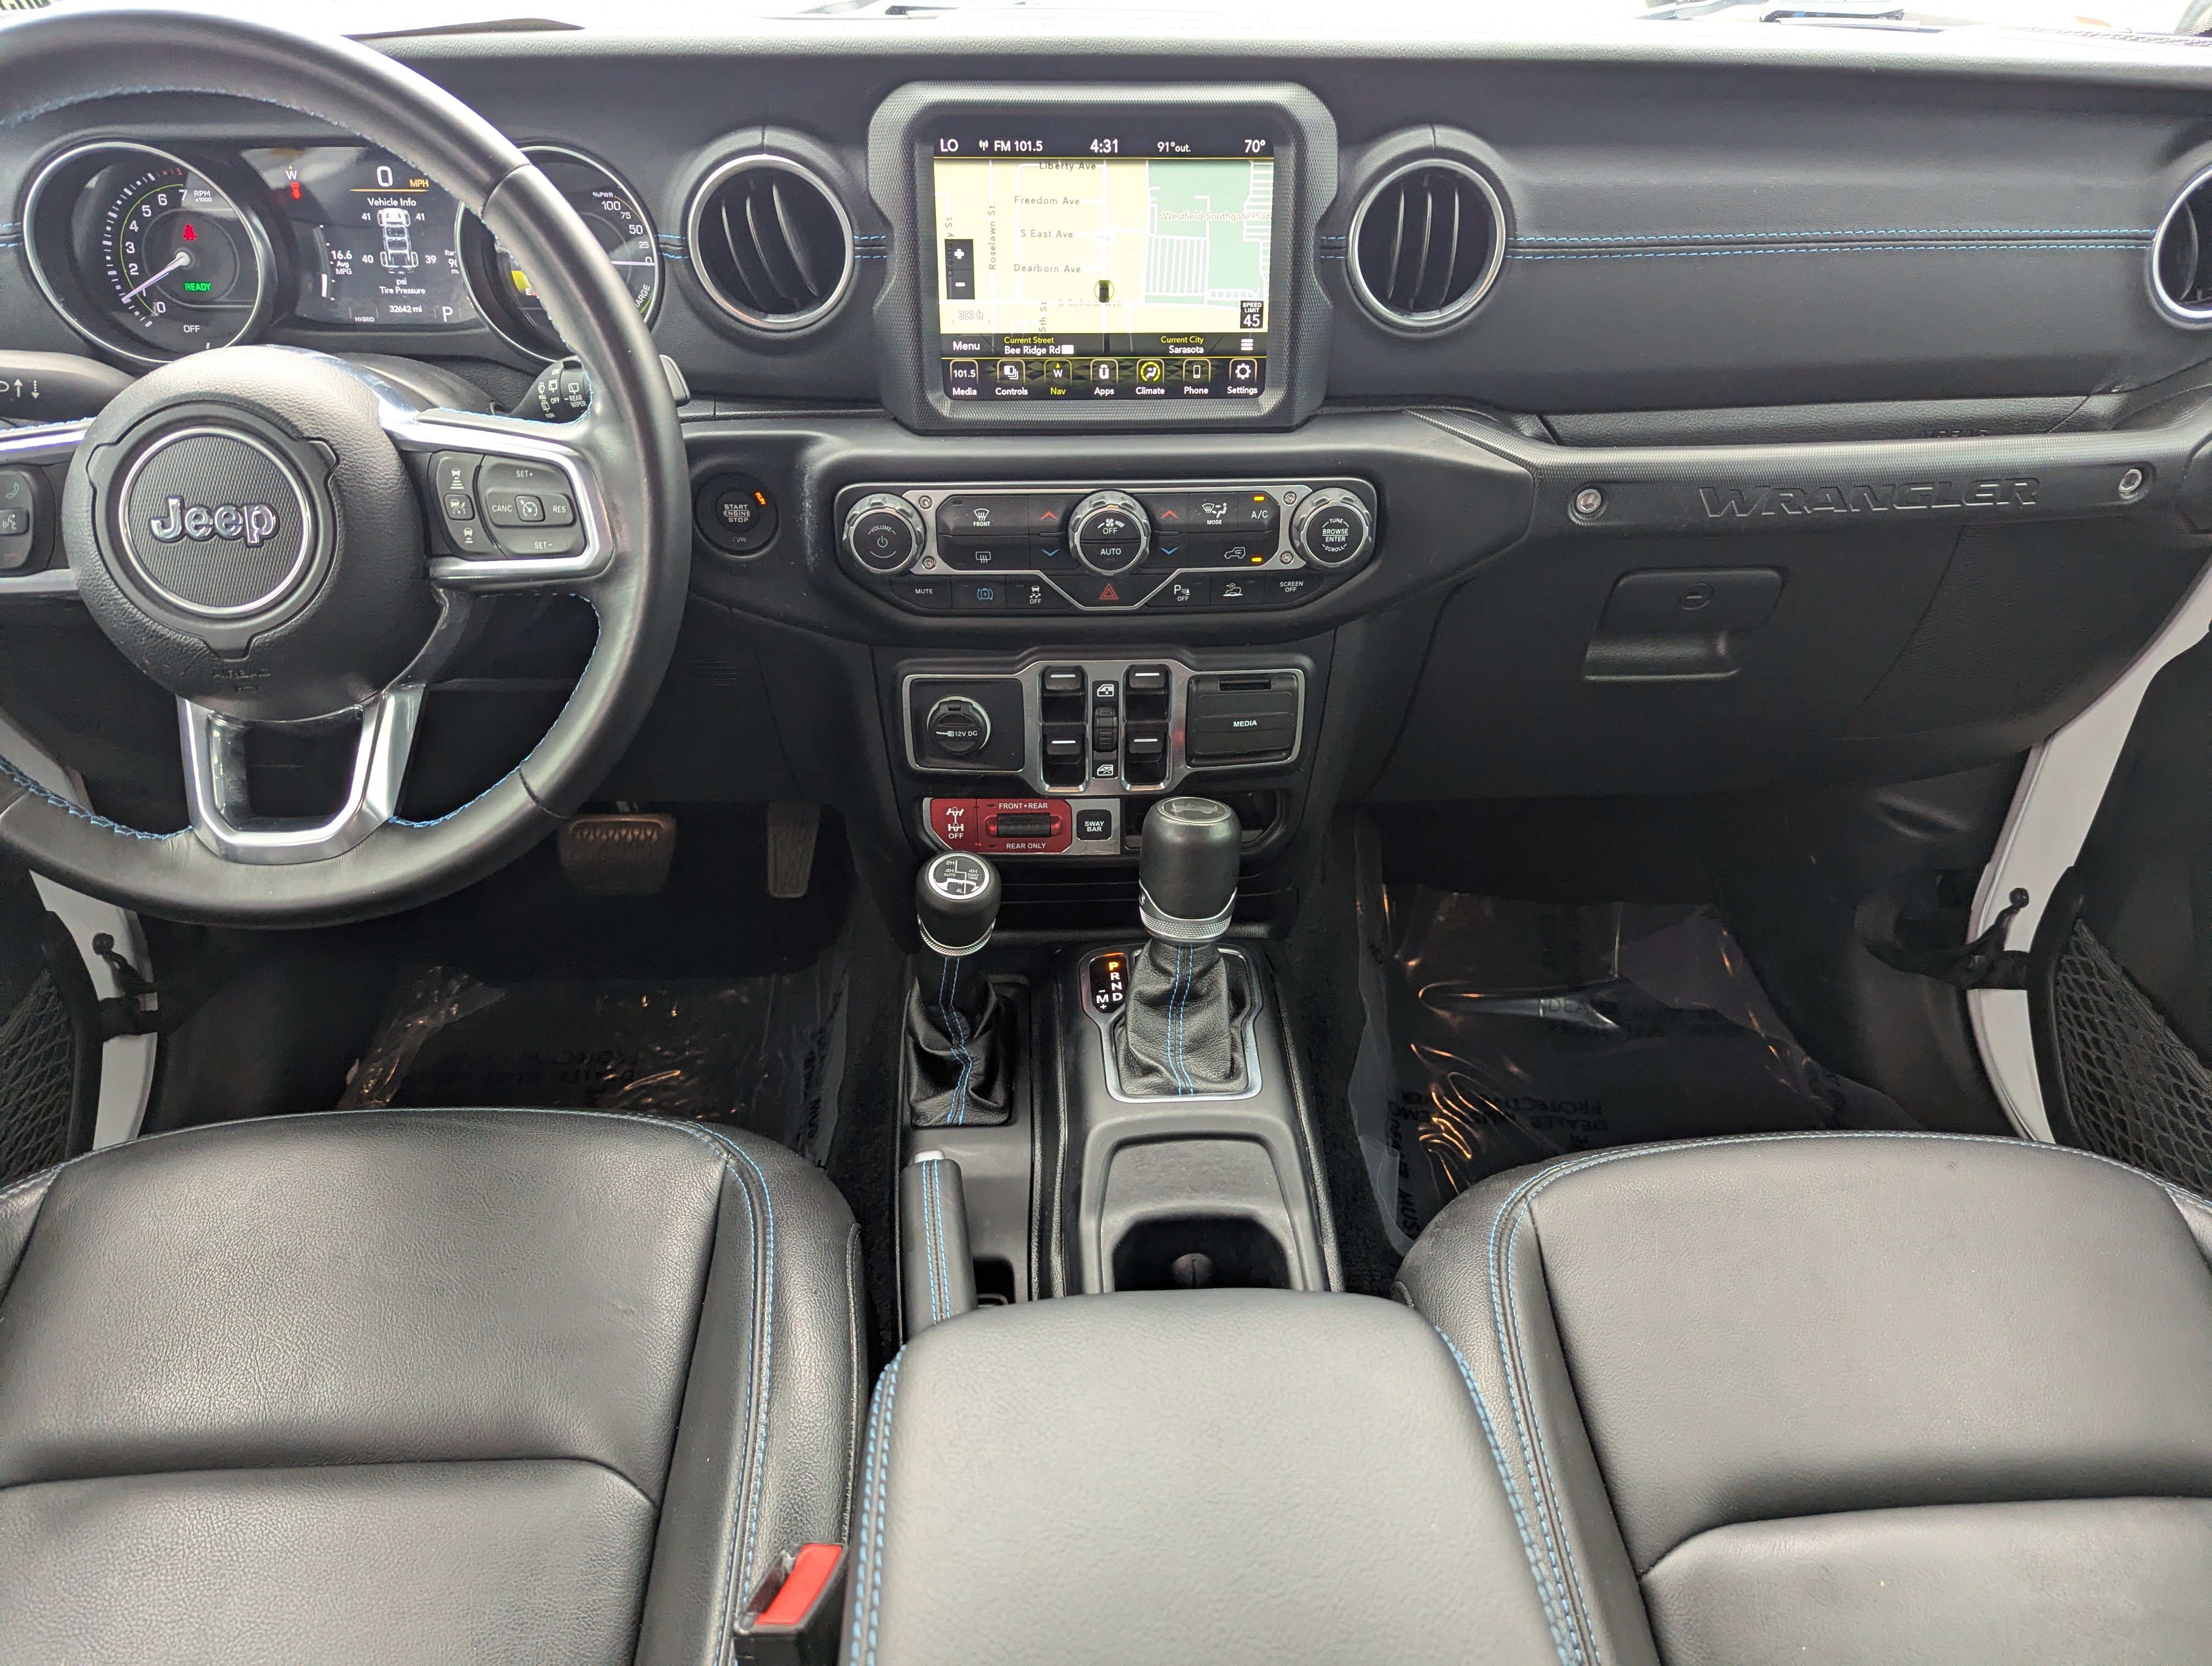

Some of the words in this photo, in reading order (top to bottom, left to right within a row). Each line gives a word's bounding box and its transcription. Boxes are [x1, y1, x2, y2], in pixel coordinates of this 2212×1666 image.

[940, 138, 959, 152] LO
[994, 140, 1011, 151] FM
[1014, 140, 1043, 152] 101.5
[1090, 138, 1118, 153] 4:31
[1244, 139, 1266, 153] 70°
[1039, 161, 1074, 171] Liberty
[1078, 162, 1096, 170] Ave
[286, 170, 297, 180] W
[377, 165, 393, 187] 0
[409, 180, 429, 188] MPH
[179, 189, 187, 201] 7
[158, 194, 168, 206] 6
[368, 197, 398, 206] Vehicle
[400, 197, 416, 206] Info
[1014, 196, 1058, 204] Freedom
[1062, 196, 1080, 205] Ave
[601, 201, 621, 210] 100
[142, 205, 151, 217] 5
[987, 205, 995, 216] St
[416, 213, 425, 221] 41
[1162, 212, 1203, 221] Westfield
[1205, 212, 1250, 222] Southgate
[129, 220, 139, 232] 4
[945, 217, 953, 228] St
[629, 225, 643, 235] 50
[1021, 229, 1026, 238] S
[1031, 229, 1052, 238] East
[1056, 230, 1073, 239] Ave
[125, 241, 135, 253] 3
[988, 221, 996, 270] Roselawn
[331, 251, 352, 260] 16.6
[362, 255, 374, 264] 40
[425, 255, 436, 264] 39
[128, 264, 139, 275] 2
[1014, 264, 1059, 273] Dearborn
[1064, 265, 1081, 273] Ave
[396, 278, 407, 286] psi
[184, 283, 211, 291] READY
[395, 286, 426, 294] Pressure
[157, 302, 166, 313] 0
[389, 305, 411, 313] 32642
[1039, 301, 1047, 311] St
[442, 306, 453, 322] P
[958, 311, 975, 320] 300
[976, 311, 983, 320] ft
[1039, 317, 1047, 332] 5th
[1243, 314, 1261, 327] 45
[183, 324, 200, 332] OFF
[1189, 336, 1204, 344] City
[953, 341, 980, 350] Menu
[1168, 345, 1204, 354] Sarasota
[1005, 346, 1020, 354] Bee
[1023, 345, 1046, 356] Ridge
[1049, 346, 1060, 354] Rd
[953, 369, 976, 377] 101.5
[1053, 369, 1063, 377] W
[953, 387, 977, 395] Media
[995, 387, 1028, 396] Controls
[1050, 387, 1066, 395] Nav
[1094, 386, 1115, 396] Apps
[1136, 386, 1165, 395] Climate
[1184, 386, 1208, 395] Phone
[1227, 386, 1258, 396] Settings
[755, 492, 766, 505] RUN
[1699, 476, 2040, 518] WRANGLER
[492, 504, 513, 512] CANC
[552, 504, 566, 513] RES
[1251, 509, 1269, 520] A/C
[150, 495, 280, 547] Jeep
[1103, 527, 1117, 535] OFF
[1100, 547, 1122, 556] AUTO
[1279, 580, 1303, 588] SCREEN
[999, 802, 1048, 810] FRONT+REAR
[1108, 962, 1119, 971] P
[1110, 972, 1121, 981] R
[1111, 982, 1122, 991] N
[1096, 994, 1109, 1003] M
[1113, 992, 1123, 1002] D
